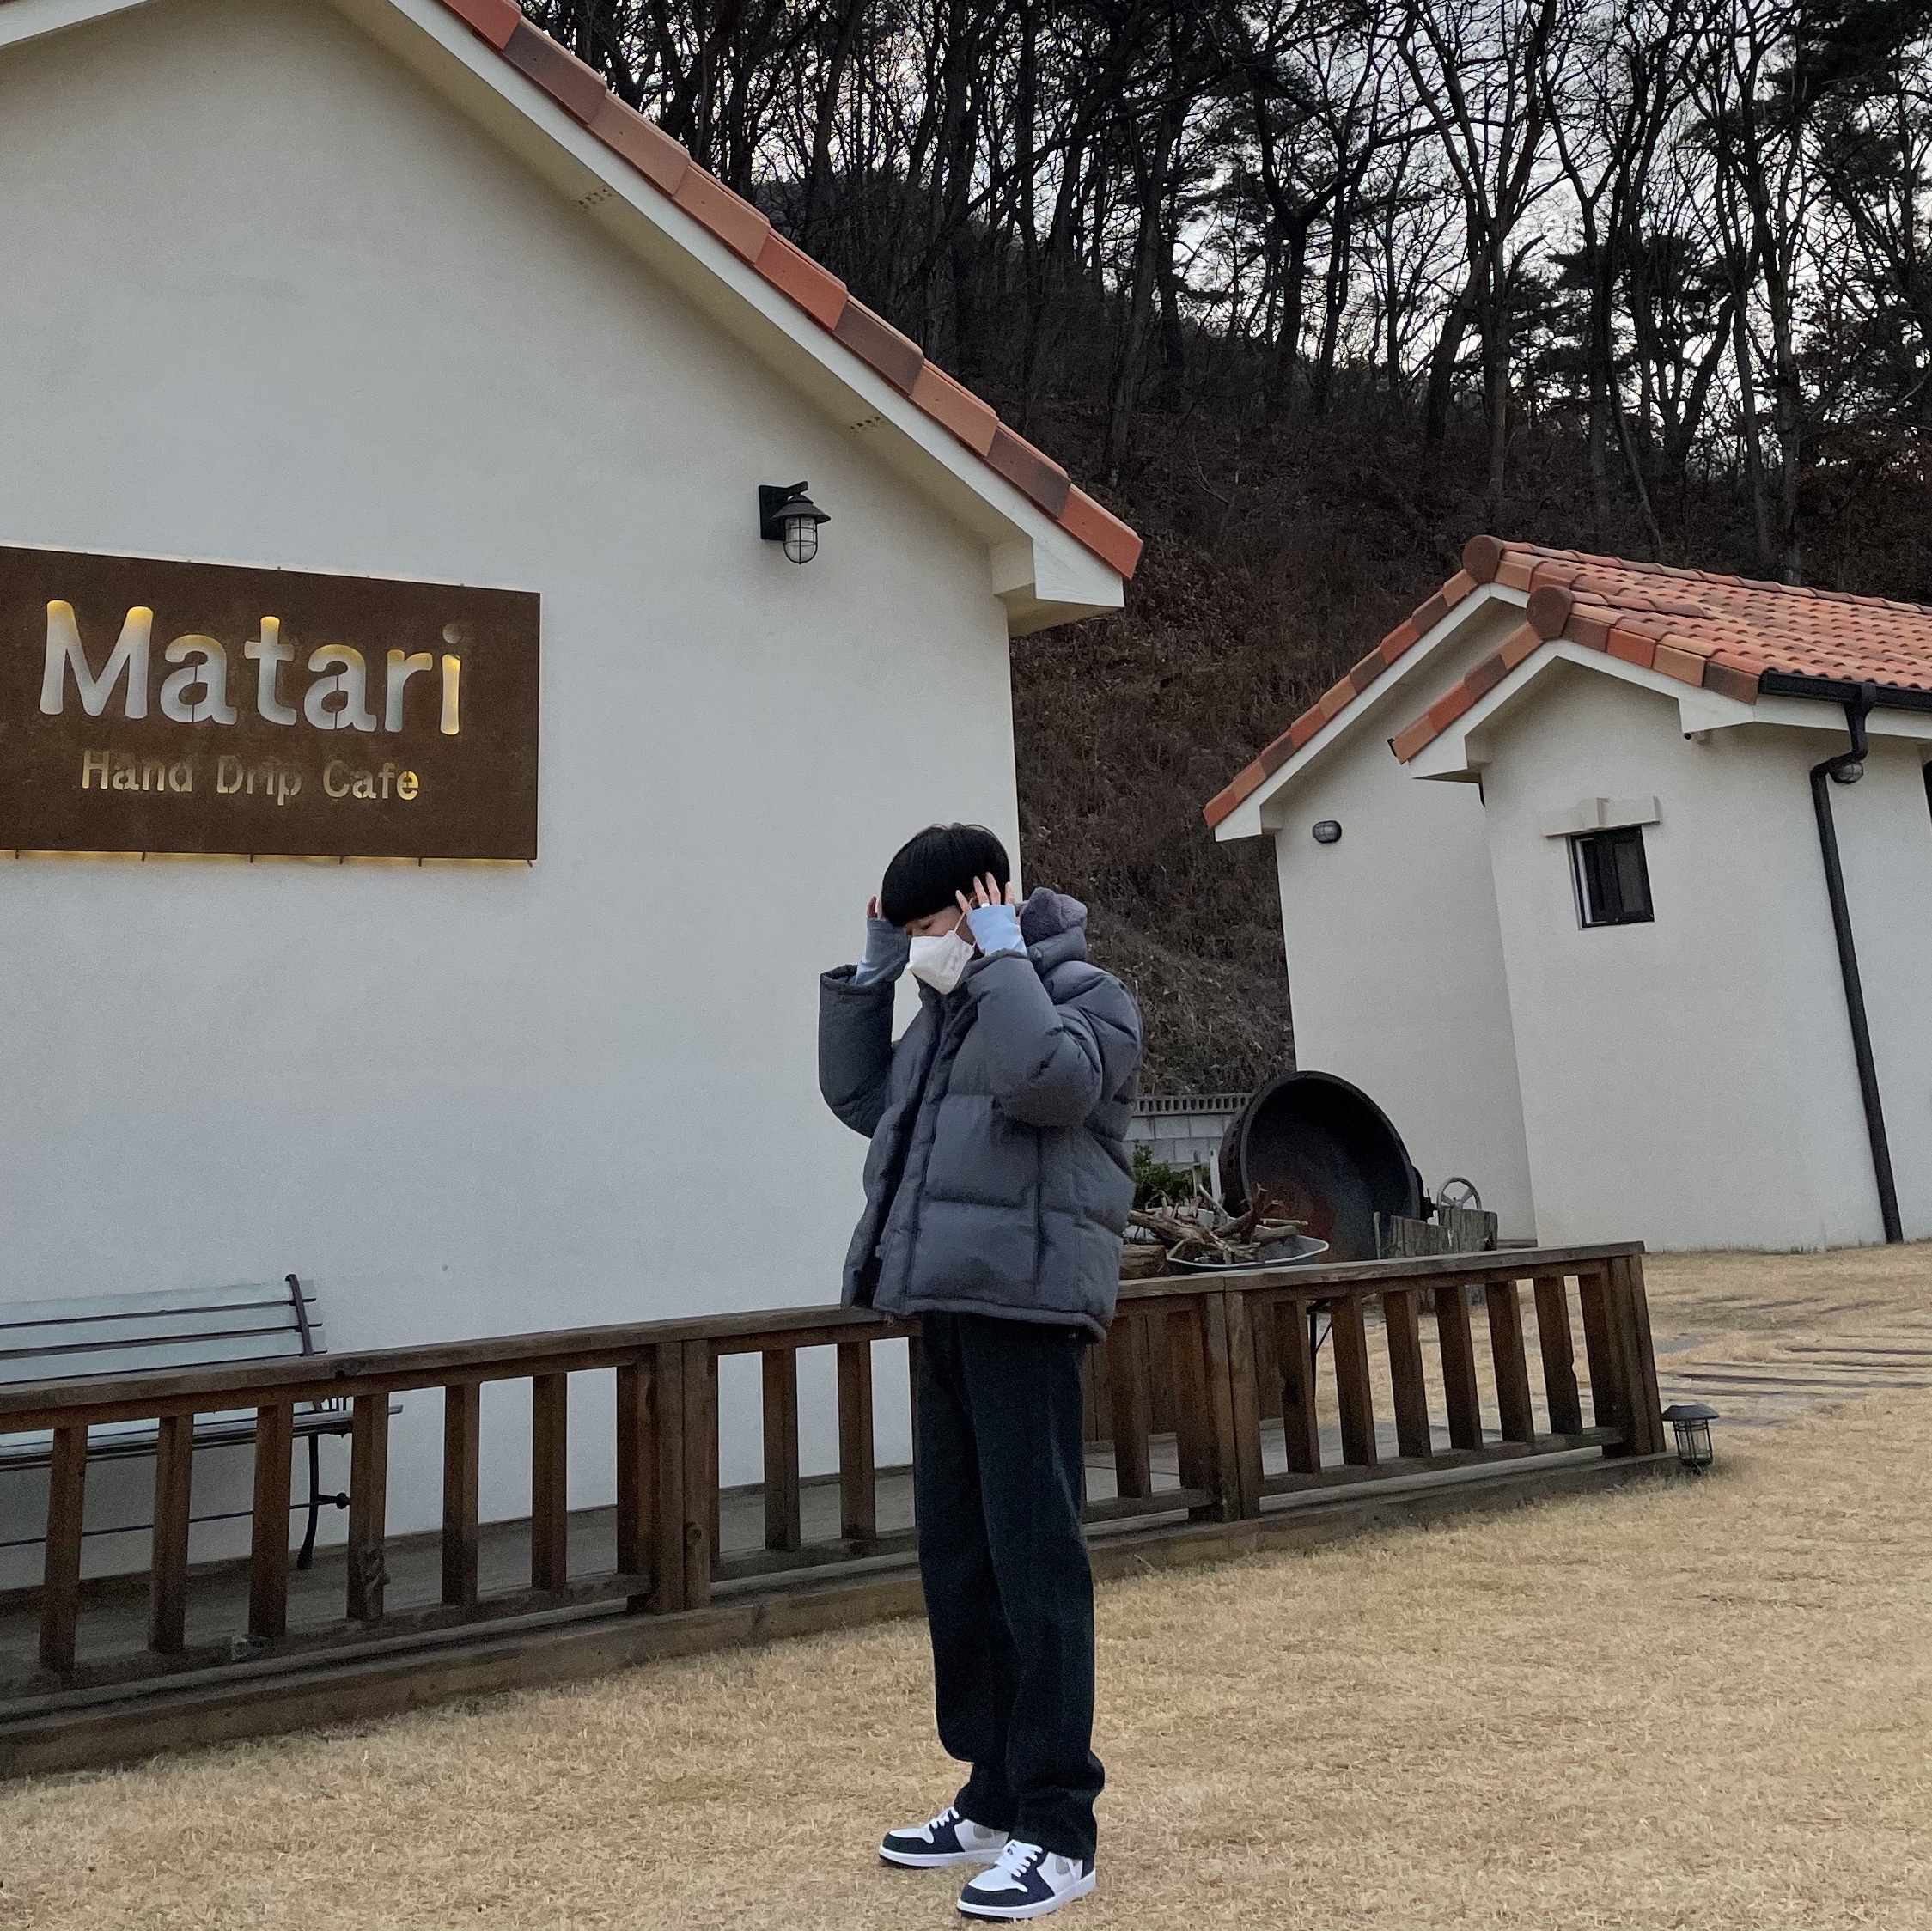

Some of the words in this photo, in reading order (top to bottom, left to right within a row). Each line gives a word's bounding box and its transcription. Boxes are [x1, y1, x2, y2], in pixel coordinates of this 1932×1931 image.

[40, 600, 463, 735] Matari
[82, 750, 193, 794] Hand
[216, 754, 302, 805] Drip
[323, 760, 419, 801] Cafe
